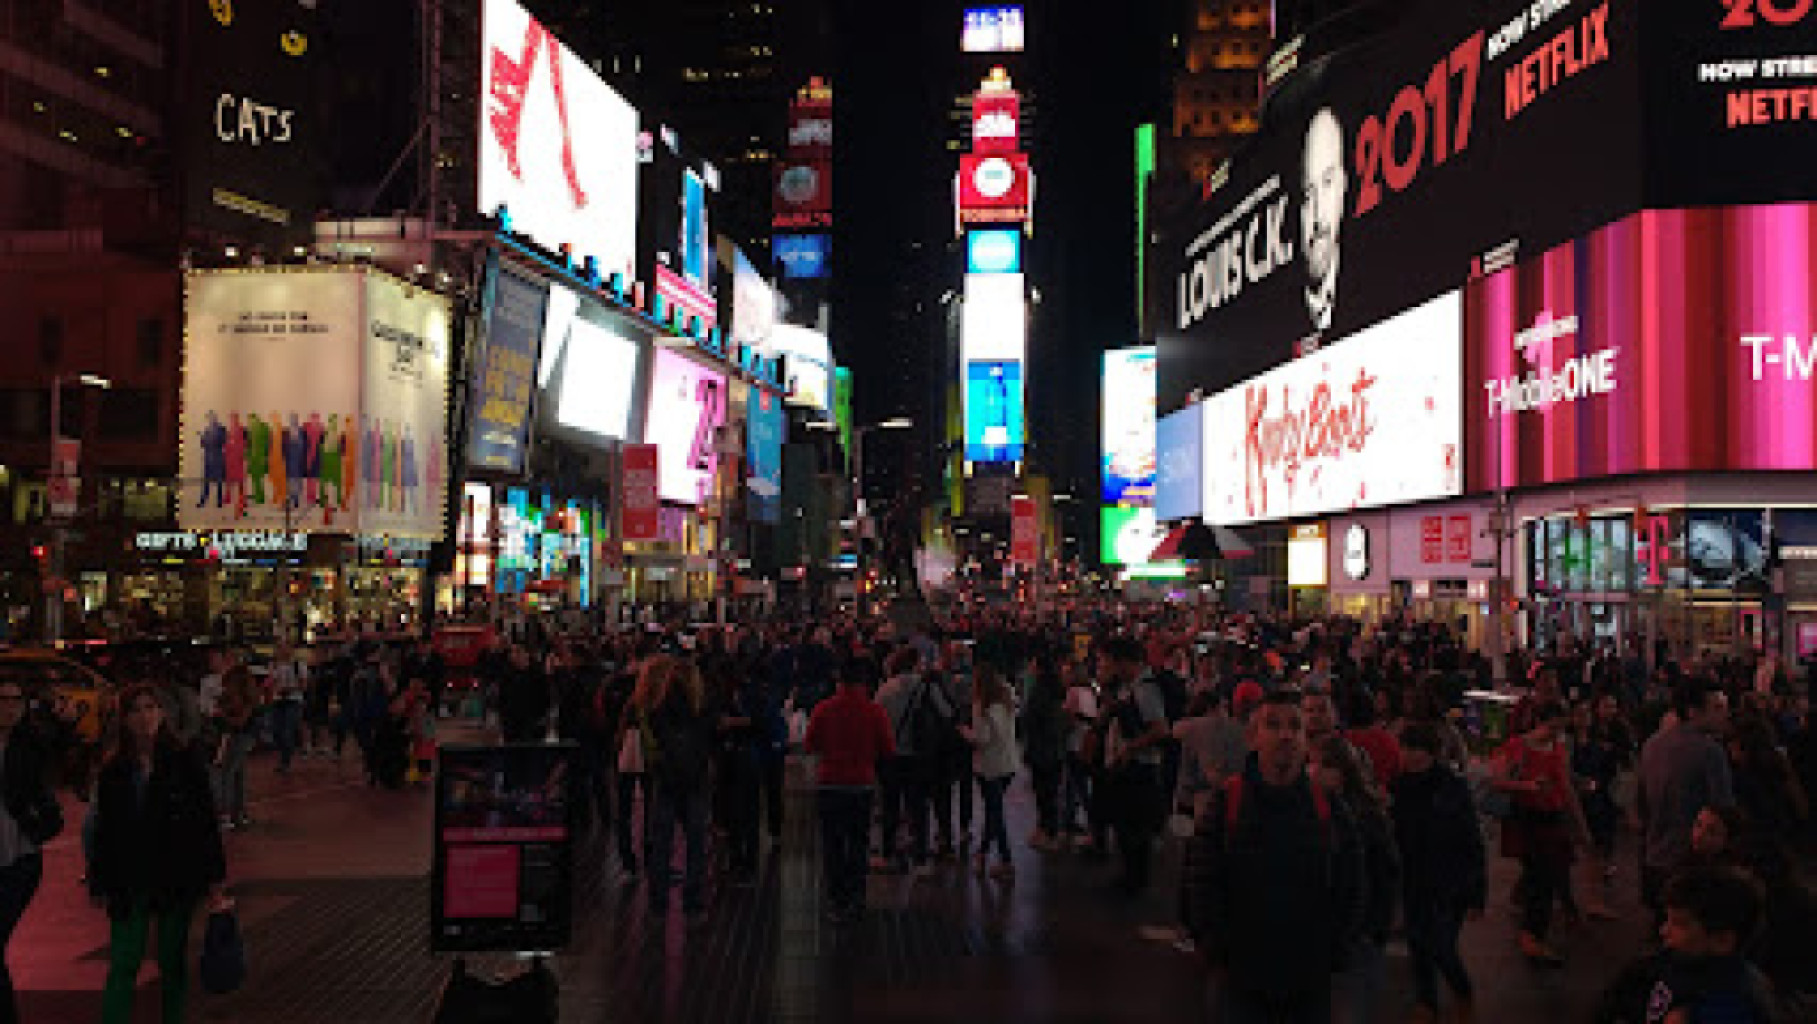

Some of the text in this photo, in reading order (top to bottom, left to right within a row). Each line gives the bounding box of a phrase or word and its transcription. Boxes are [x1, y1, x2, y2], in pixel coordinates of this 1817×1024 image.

[1487, 9, 1528, 60] NOW
[1504, 1, 1608, 120] NETFLIX
[1698, 59, 1758, 82] NOW
[214, 93, 295, 145] CATS
[1352, 28, 1485, 218] 2017
[1177, 230, 1241, 328] LOUIS
